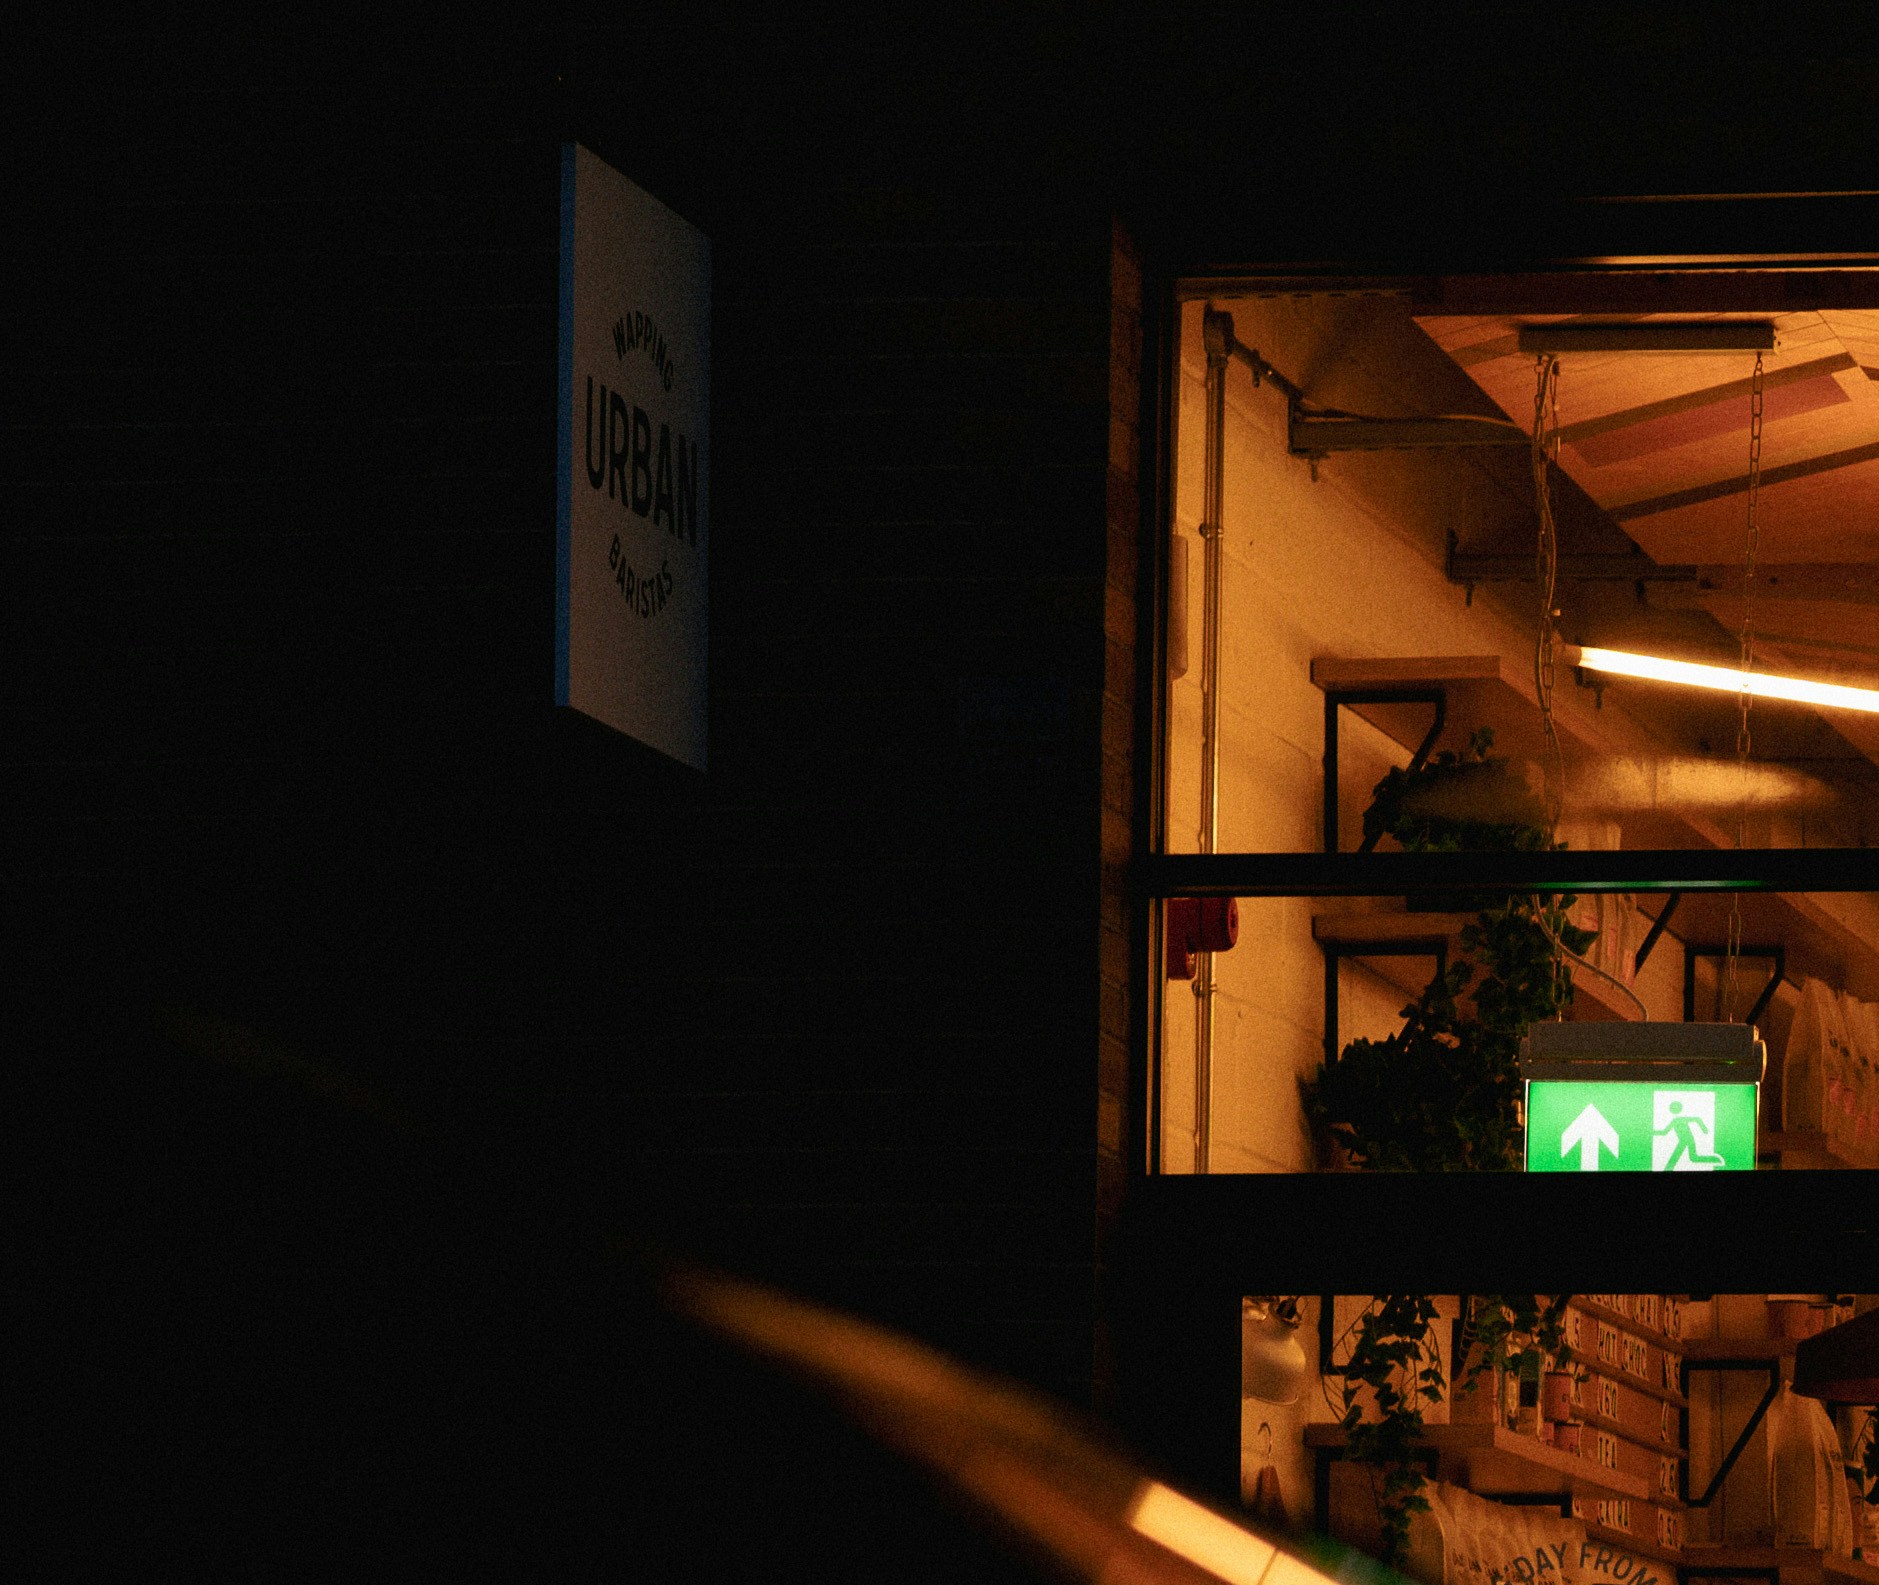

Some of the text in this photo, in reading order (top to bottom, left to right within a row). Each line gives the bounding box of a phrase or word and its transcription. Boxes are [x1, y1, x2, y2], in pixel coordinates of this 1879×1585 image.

[612, 310, 674, 392] WAPPING
[586, 374, 698, 549] URBAN
[609, 533, 674, 620] BARISTAS
